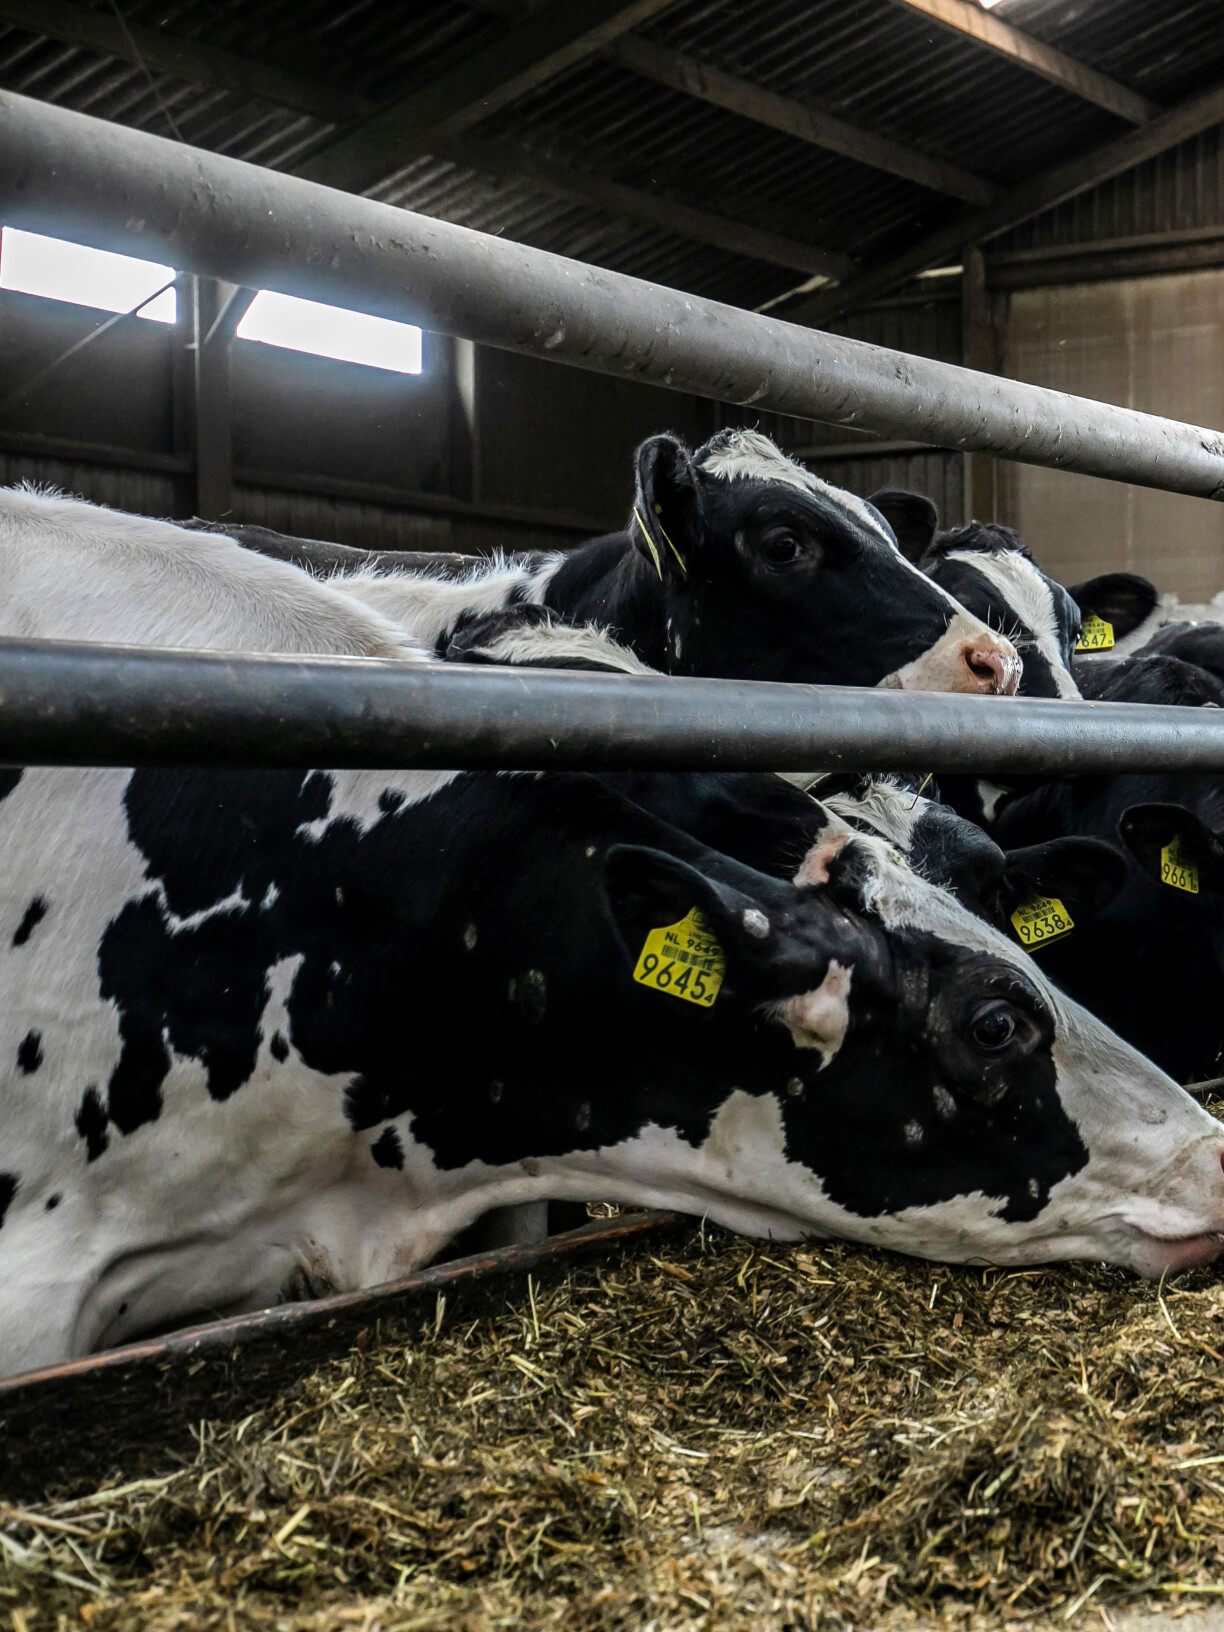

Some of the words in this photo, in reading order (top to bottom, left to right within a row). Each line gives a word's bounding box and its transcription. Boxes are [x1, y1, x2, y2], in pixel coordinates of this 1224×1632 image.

[1077, 633, 1106, 647] 647
[1163, 863, 1193, 891] 9661
[665, 931, 680, 945] NL
[1020, 914, 1065, 942] 9638
[640, 953, 711, 1000] 9645
[704, 993, 714, 1003] 4
